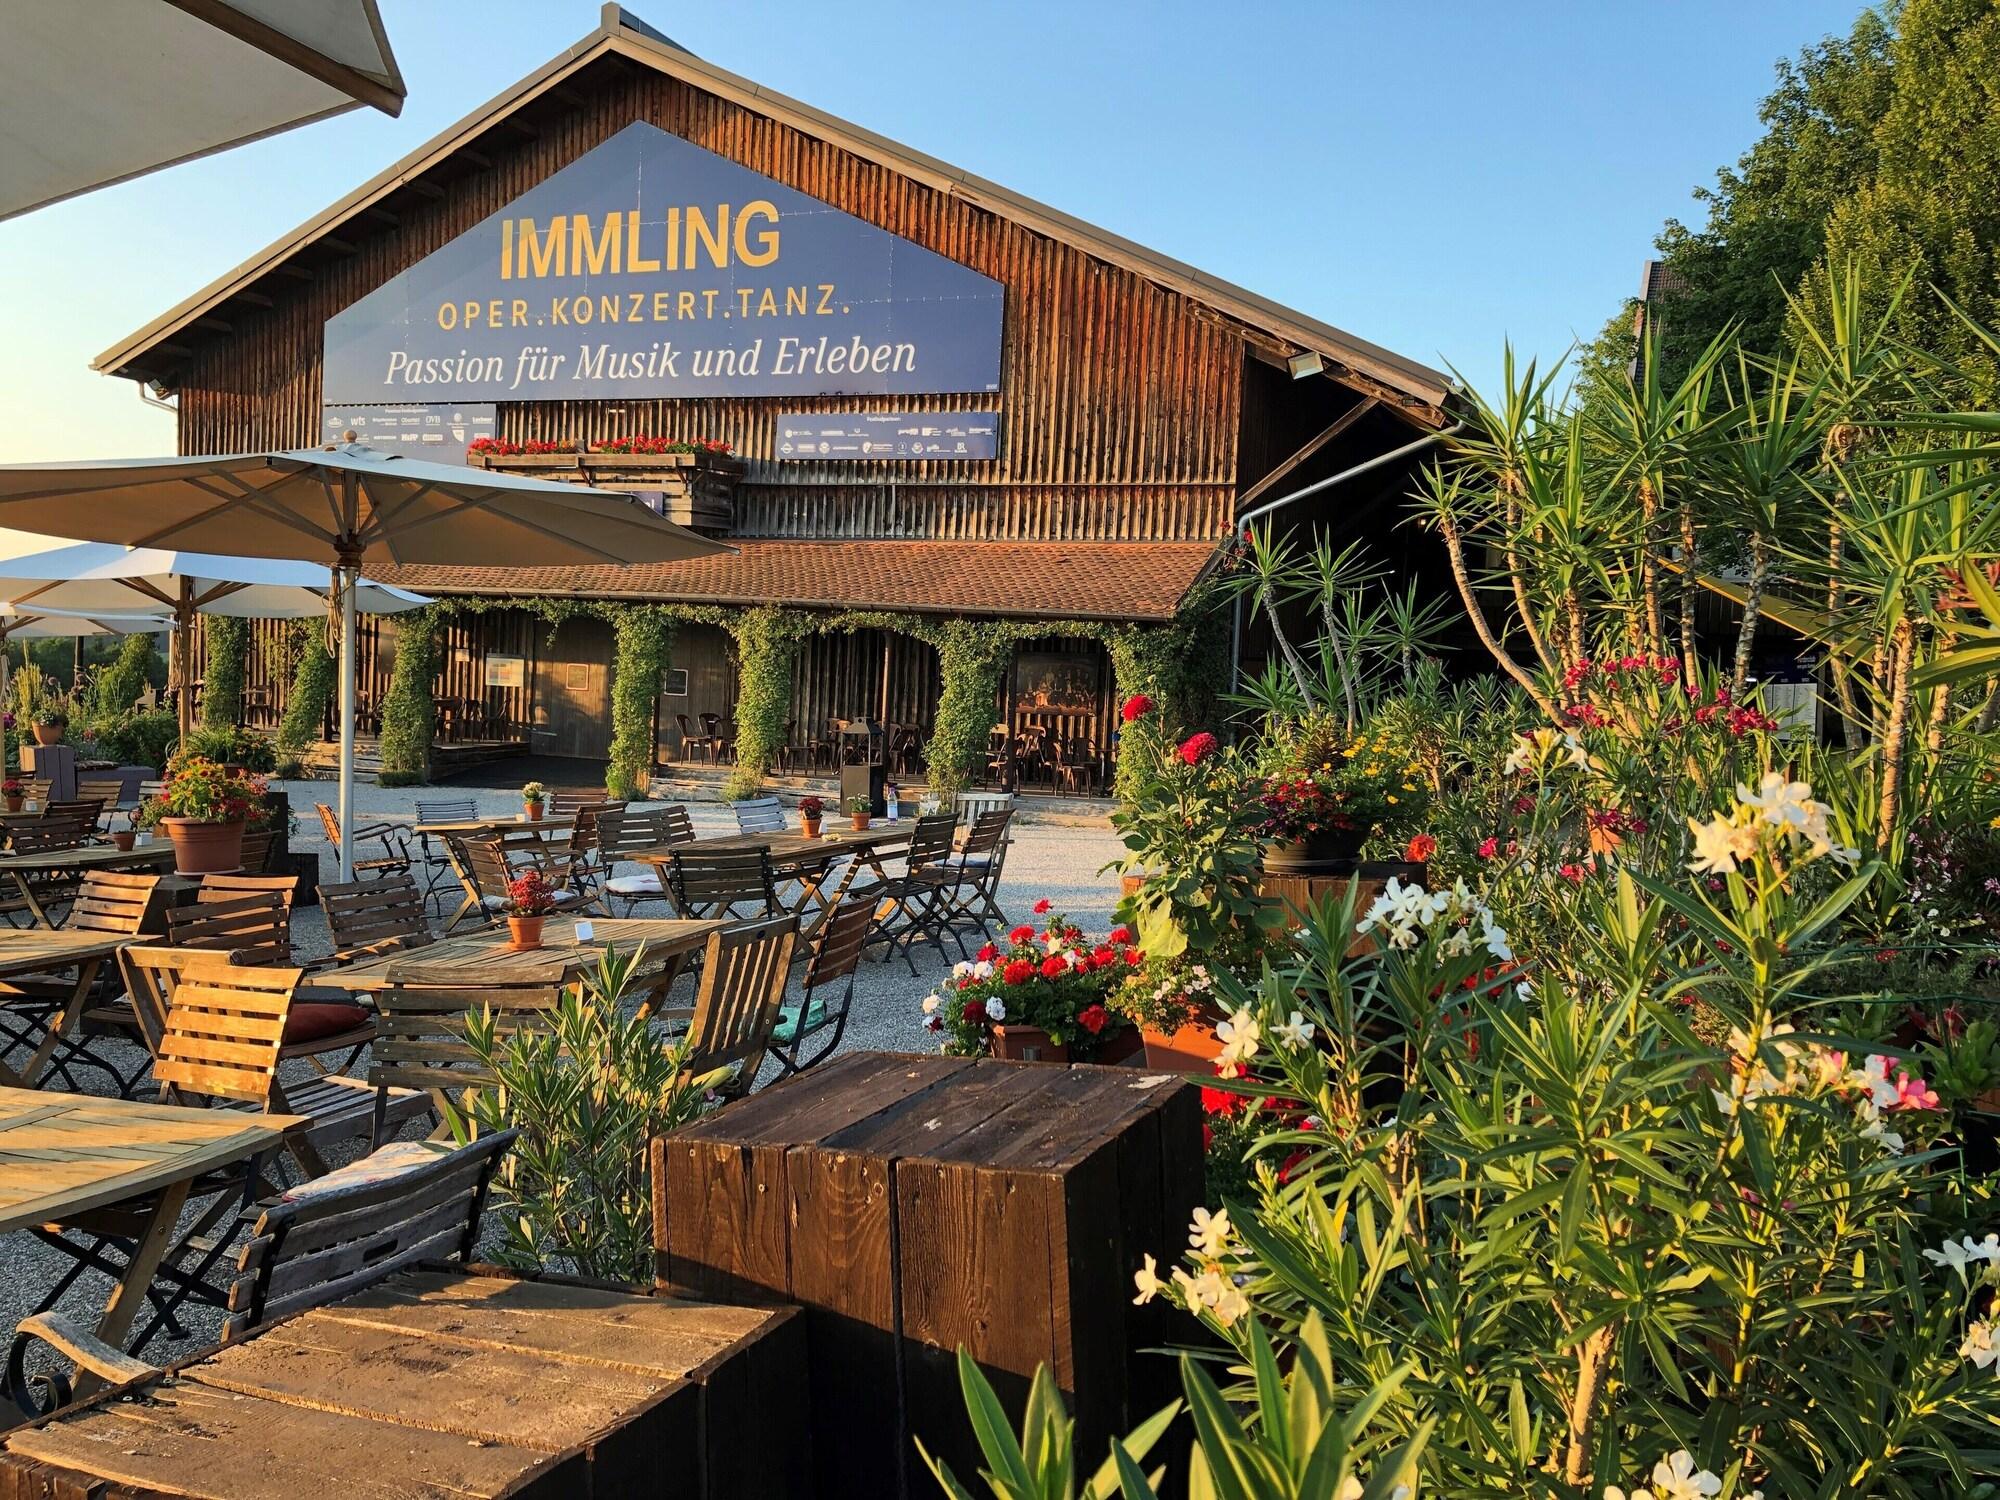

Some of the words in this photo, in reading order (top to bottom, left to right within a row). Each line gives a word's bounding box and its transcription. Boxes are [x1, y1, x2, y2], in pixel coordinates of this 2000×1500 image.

[500, 200, 781, 280] IMMLING
[384, 349, 504, 385] Passion
[508, 346, 566, 391] für
[571, 342, 682, 381] Musik
[692, 338, 763, 377] und
[770, 335, 916, 375] Erleben
